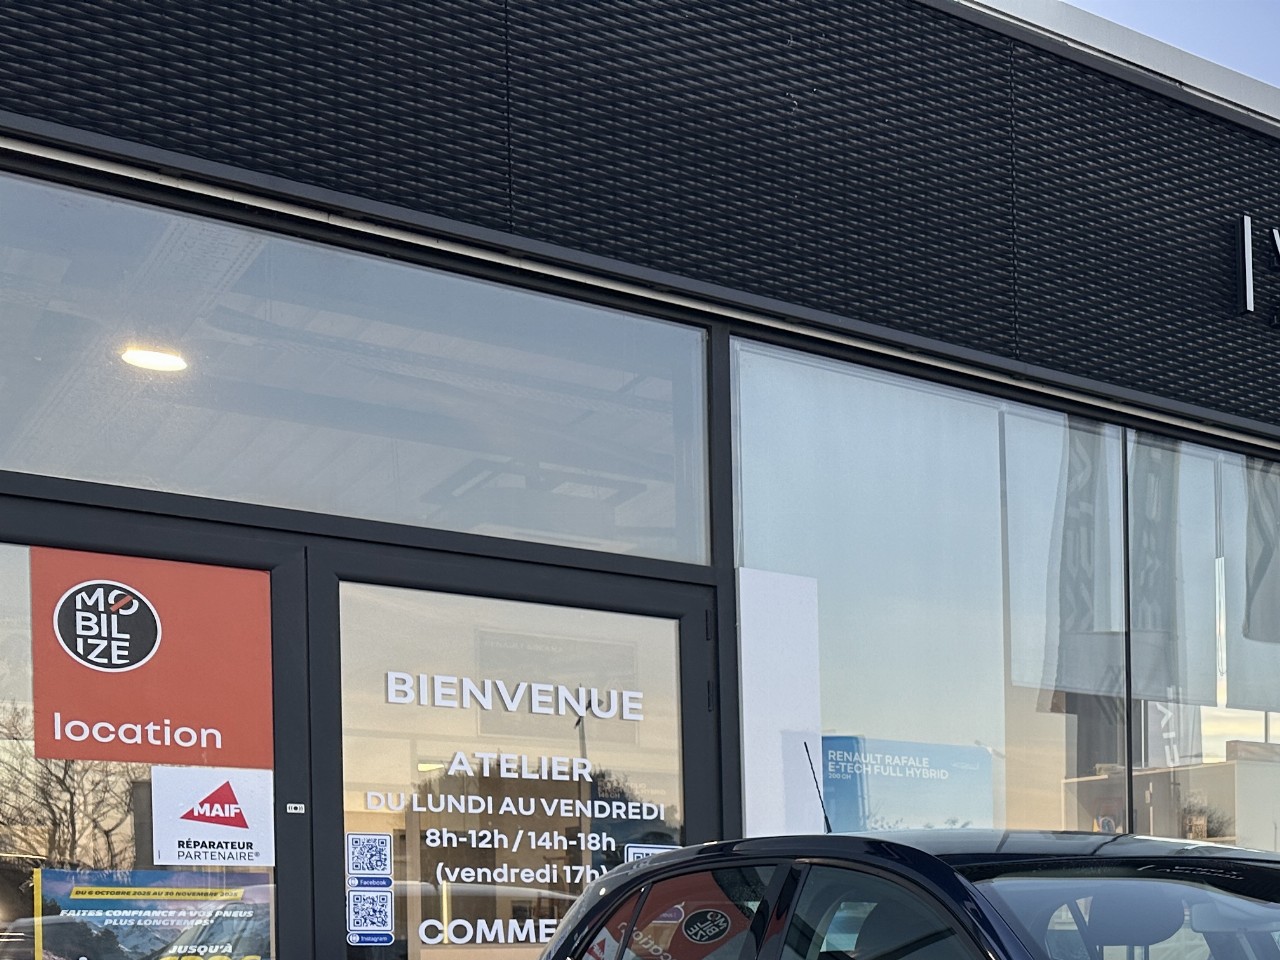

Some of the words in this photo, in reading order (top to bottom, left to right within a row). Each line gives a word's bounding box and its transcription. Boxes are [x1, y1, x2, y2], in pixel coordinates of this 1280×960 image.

[75, 611, 130, 639] BIL
[76, 637, 130, 665] IZE
[387, 671, 644, 721] BIENVENUE
[53, 712, 222, 749] location
[448, 751, 593, 783] ATELIER
[828, 750, 883, 763] RENAULT
[885, 755, 930, 768] RAFALE
[828, 762, 872, 775] E-TECH
[874, 765, 904, 777] FULL
[906, 768, 949, 780] HYBRID
[193, 803, 240, 818] MAIF
[366, 791, 405, 811] DU
[413, 793, 492, 815] LUNDI
[499, 795, 535, 816] AU
[540, 797, 665, 821] VENDREDI
[177, 838, 254, 850] RÉPARATEUR
[425, 828, 508, 850] 8h-12h
[512, 831, 522, 852] /
[528, 830, 616, 852] 14h-18h
[435, 862, 558, 885] (vendredi
[59, 909, 103, 917] FAITES
[105, 909, 174, 917] CONFIANCE
[214, 910, 254, 918] PNEUS
[103, 918, 135, 926] PLUS
[360, 935, 388, 943] Instagram
[418, 918, 563, 945] COMME
[168, 943, 233, 955] JUSQU'À
